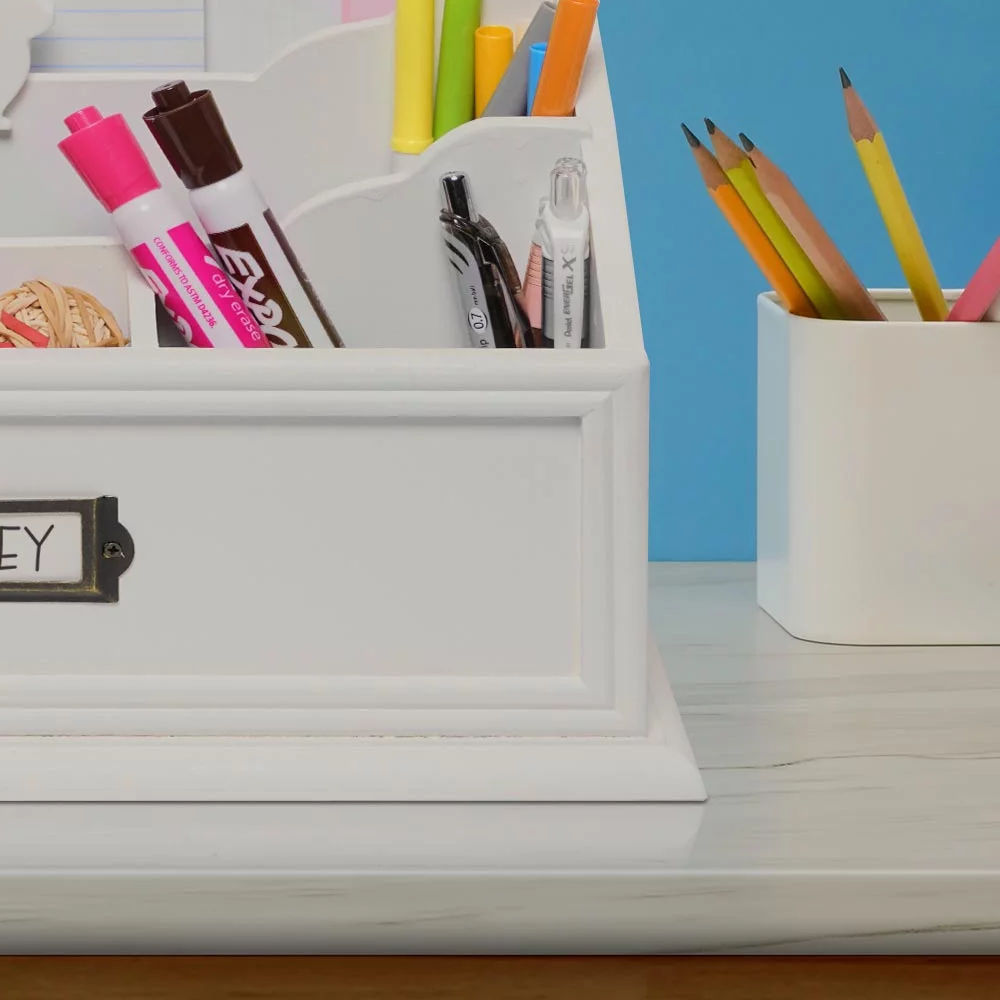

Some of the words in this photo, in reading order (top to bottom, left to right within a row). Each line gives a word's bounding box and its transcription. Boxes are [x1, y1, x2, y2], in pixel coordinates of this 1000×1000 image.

[153, 236, 181, 275] CONFORMS
[183, 285, 202, 304] ASTM
[211, 273, 235, 297] dry
[230, 301, 261, 340] erase
[470, 313, 484, 330] 0.7
